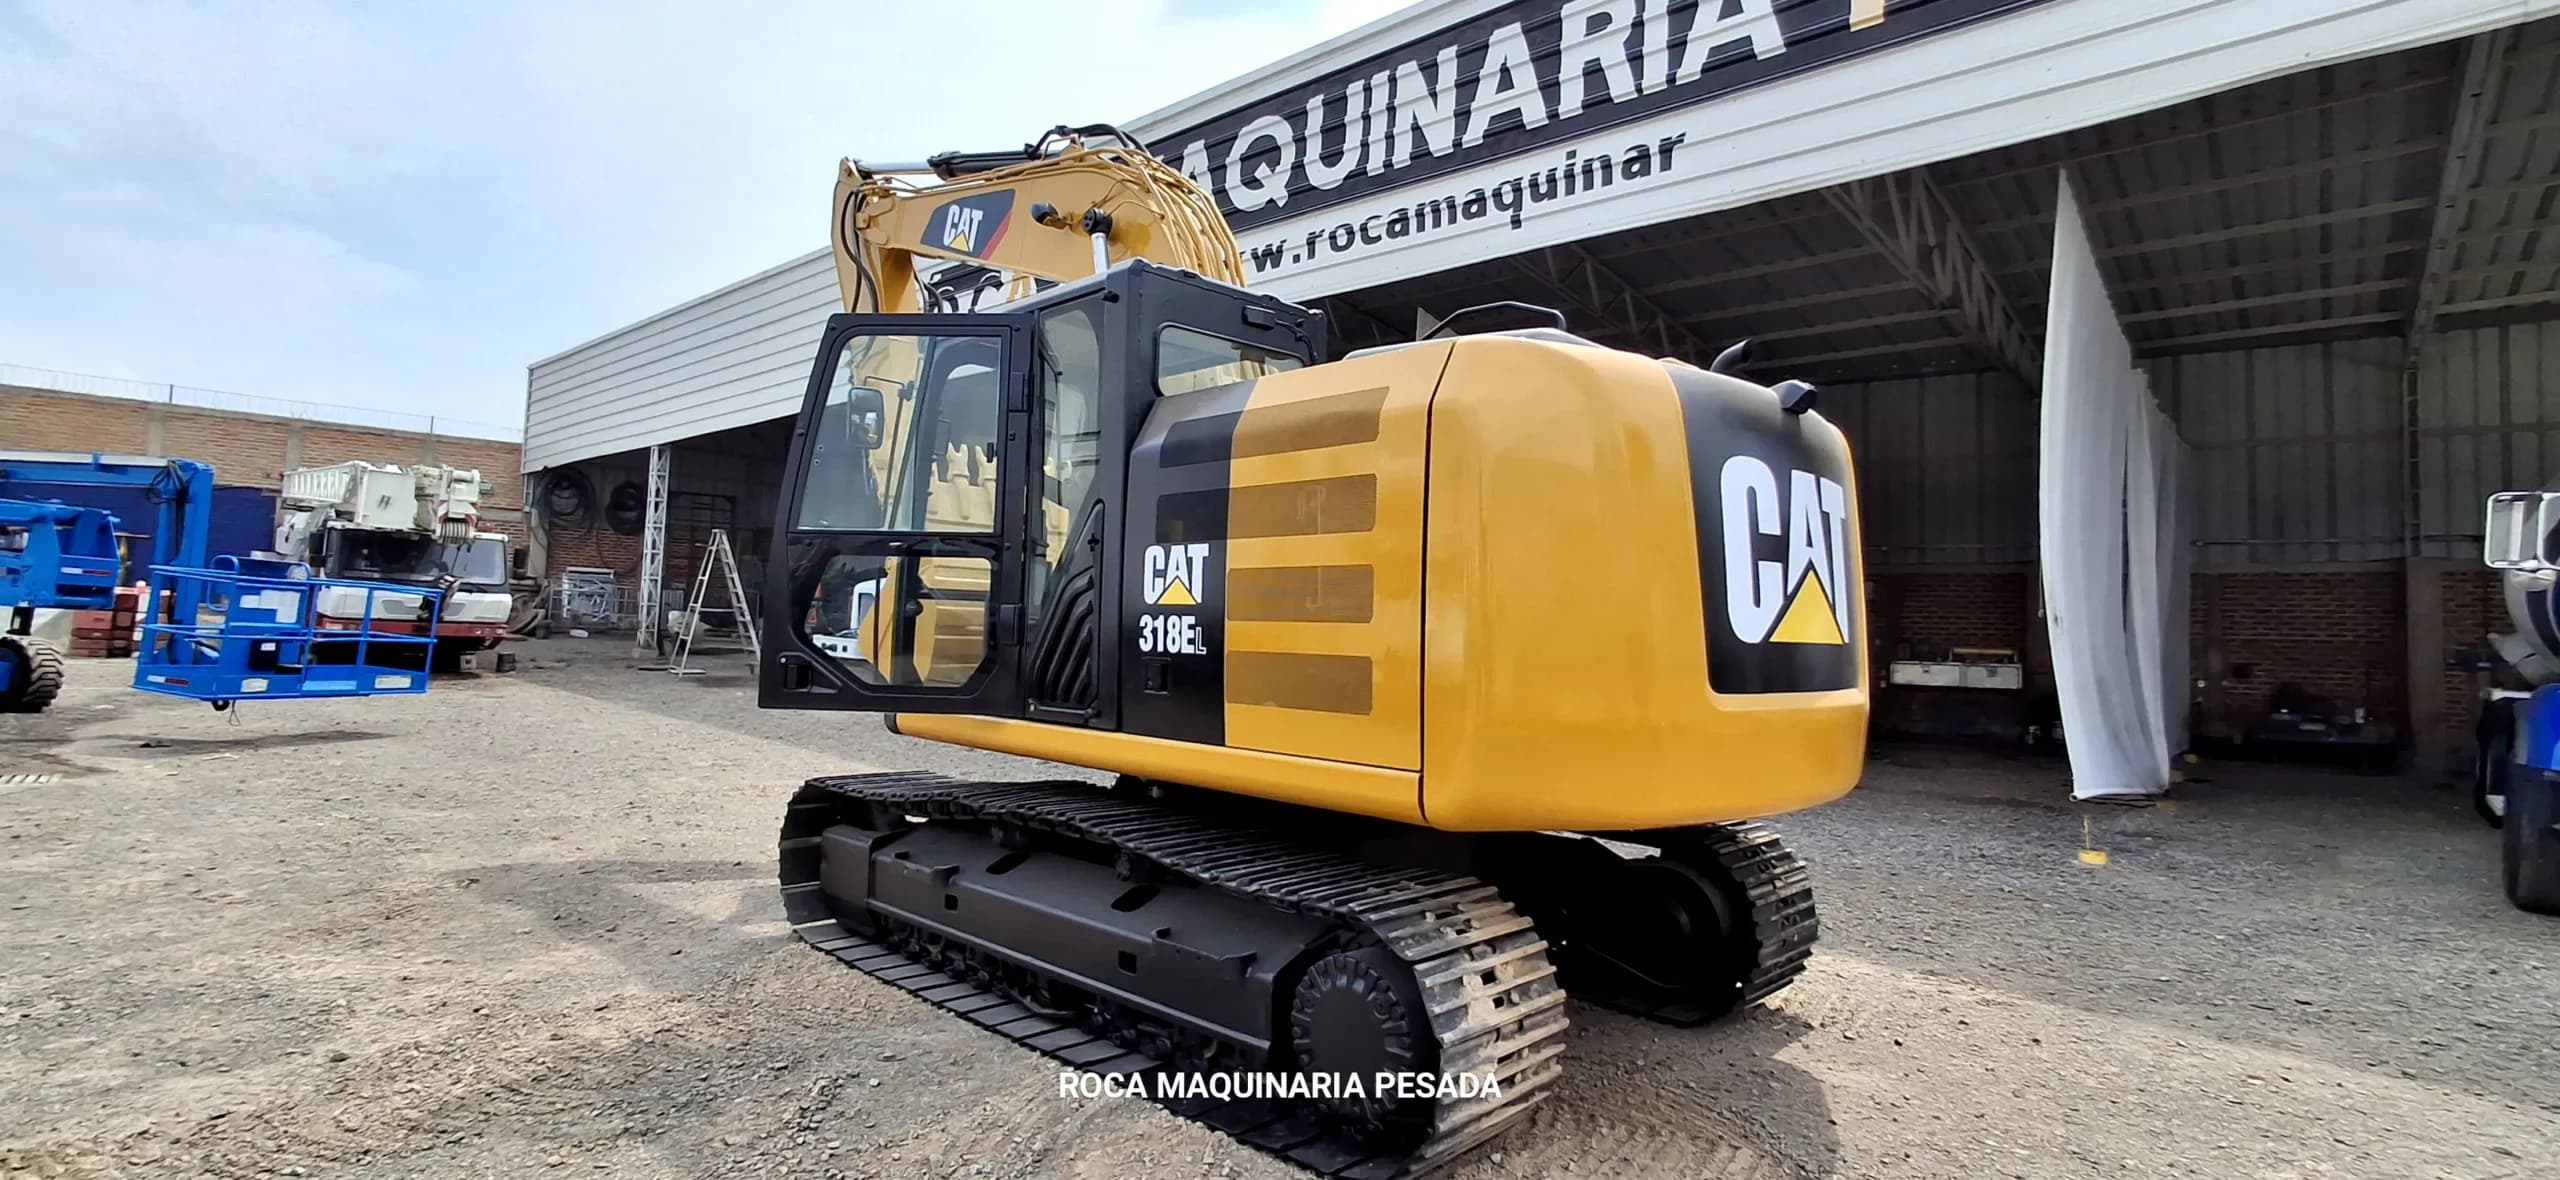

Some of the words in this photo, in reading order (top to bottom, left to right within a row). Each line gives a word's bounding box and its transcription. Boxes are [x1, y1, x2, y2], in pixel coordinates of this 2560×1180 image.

[1157, 0, 1787, 212] AQUINARIA
[943, 204, 984, 253] CAT
[1240, 132, 1687, 273] w.rocamaquinar
[1143, 543, 1209, 606] CAT
[1720, 455, 1850, 644] CAT
